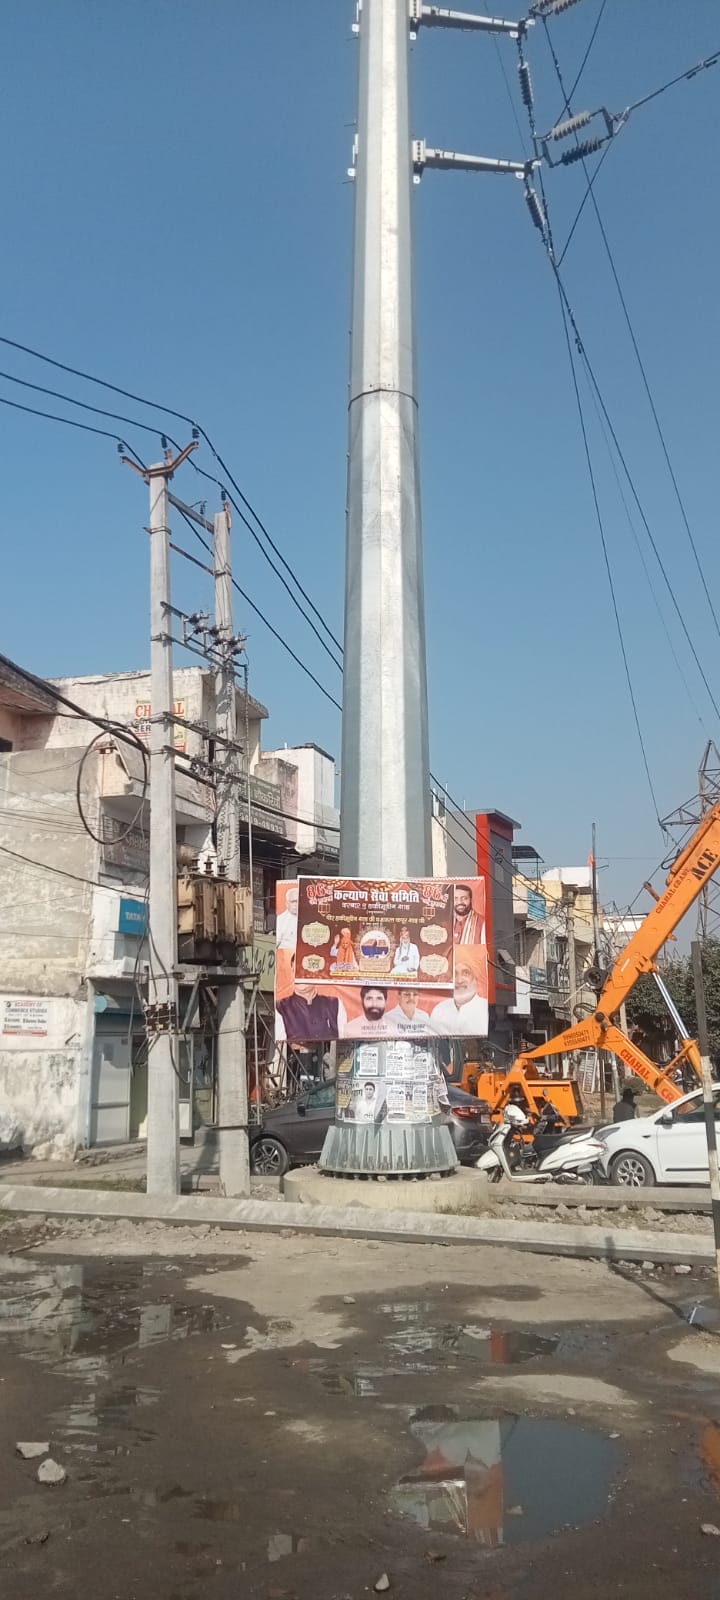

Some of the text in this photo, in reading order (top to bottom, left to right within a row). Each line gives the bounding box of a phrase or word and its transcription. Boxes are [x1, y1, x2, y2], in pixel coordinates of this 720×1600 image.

[691, 848, 718, 881] ACE
[333, 889, 369, 901] कल्याण
[370, 888, 389, 902] सेवा
[391, 889, 420, 903] समिति
[655, 888, 677, 914] CHAHAL
[619, 1048, 650, 1081] CHAHAL
